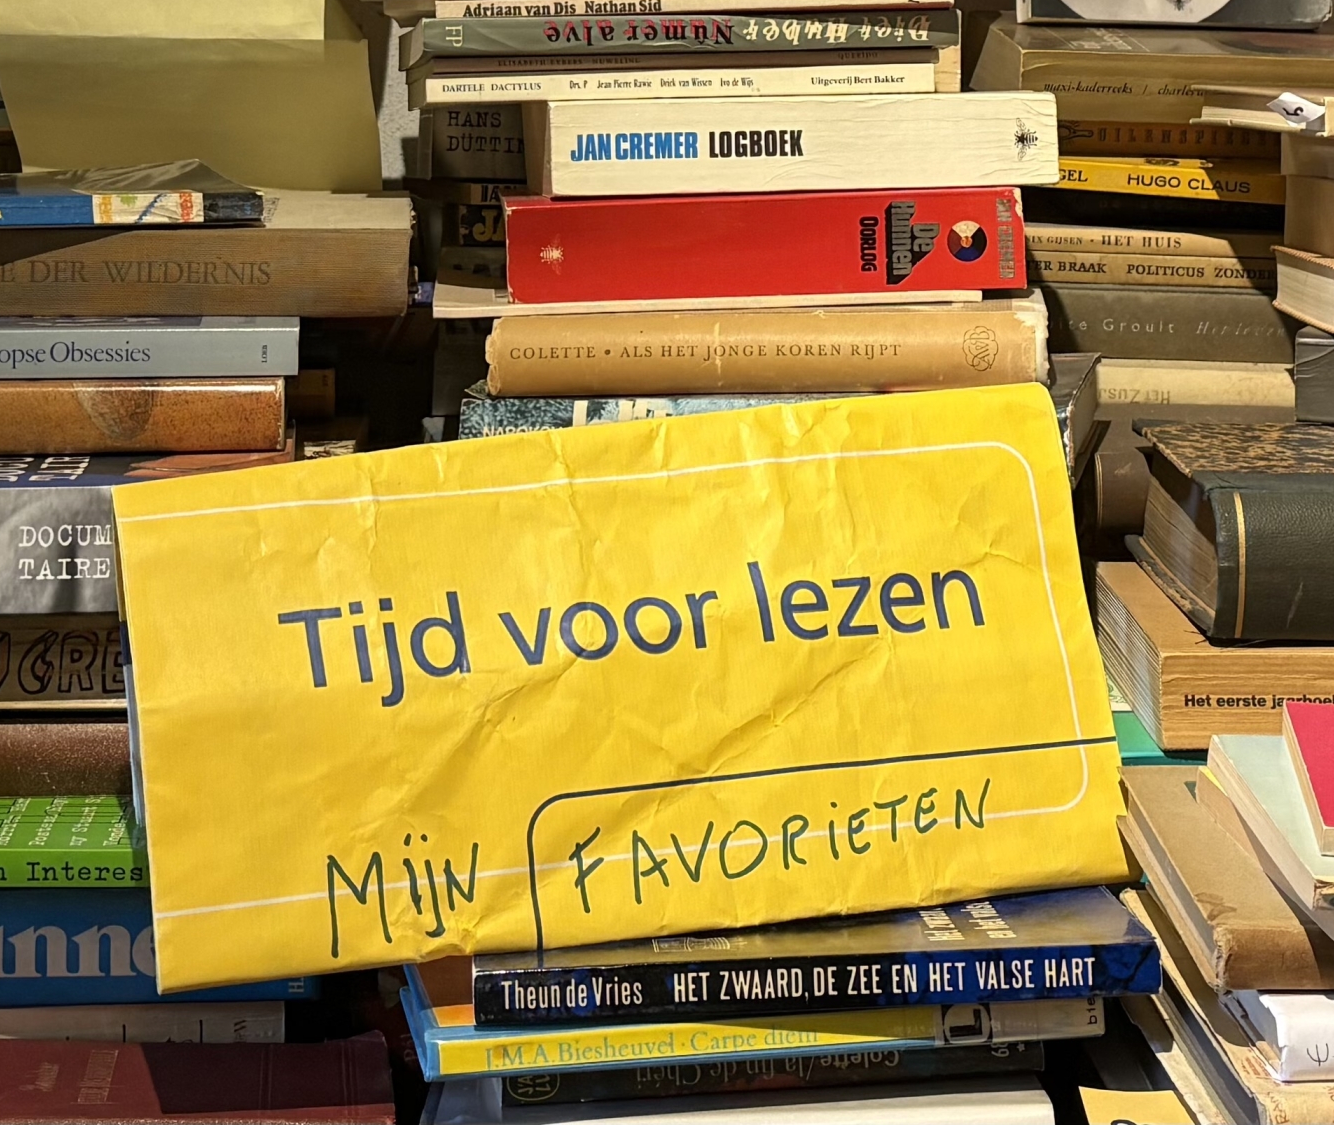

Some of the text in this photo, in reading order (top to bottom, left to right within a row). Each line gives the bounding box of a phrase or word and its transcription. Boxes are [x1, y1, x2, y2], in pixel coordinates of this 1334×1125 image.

[570, 130, 803, 162] JAN CREMER LOGBOEK
[1128, 174, 1250, 193] HUGO CLAUS
[49, 341, 149, 364] Obsessies
[510, 346, 596, 360] COLETTE
[620, 345, 652, 359] ALS
[660, 345, 696, 358] HET
[702, 345, 768, 362] JONGE
[775, 343, 841, 357] KOREN
[278, 562, 986, 708] Tijd voor lezen
[501, 981, 560, 1010] Theun
[566, 979, 587, 1008] de
[591, 976, 643, 1006] Vries
[673, 973, 708, 1003] HET
[815, 971, 840, 997] DE
[847, 968, 882, 996] ZEE
[891, 966, 917, 995] EN
[929, 964, 964, 992] HET
[975, 961, 1034, 991] VALSE
[1044, 957, 1095, 988] HART
